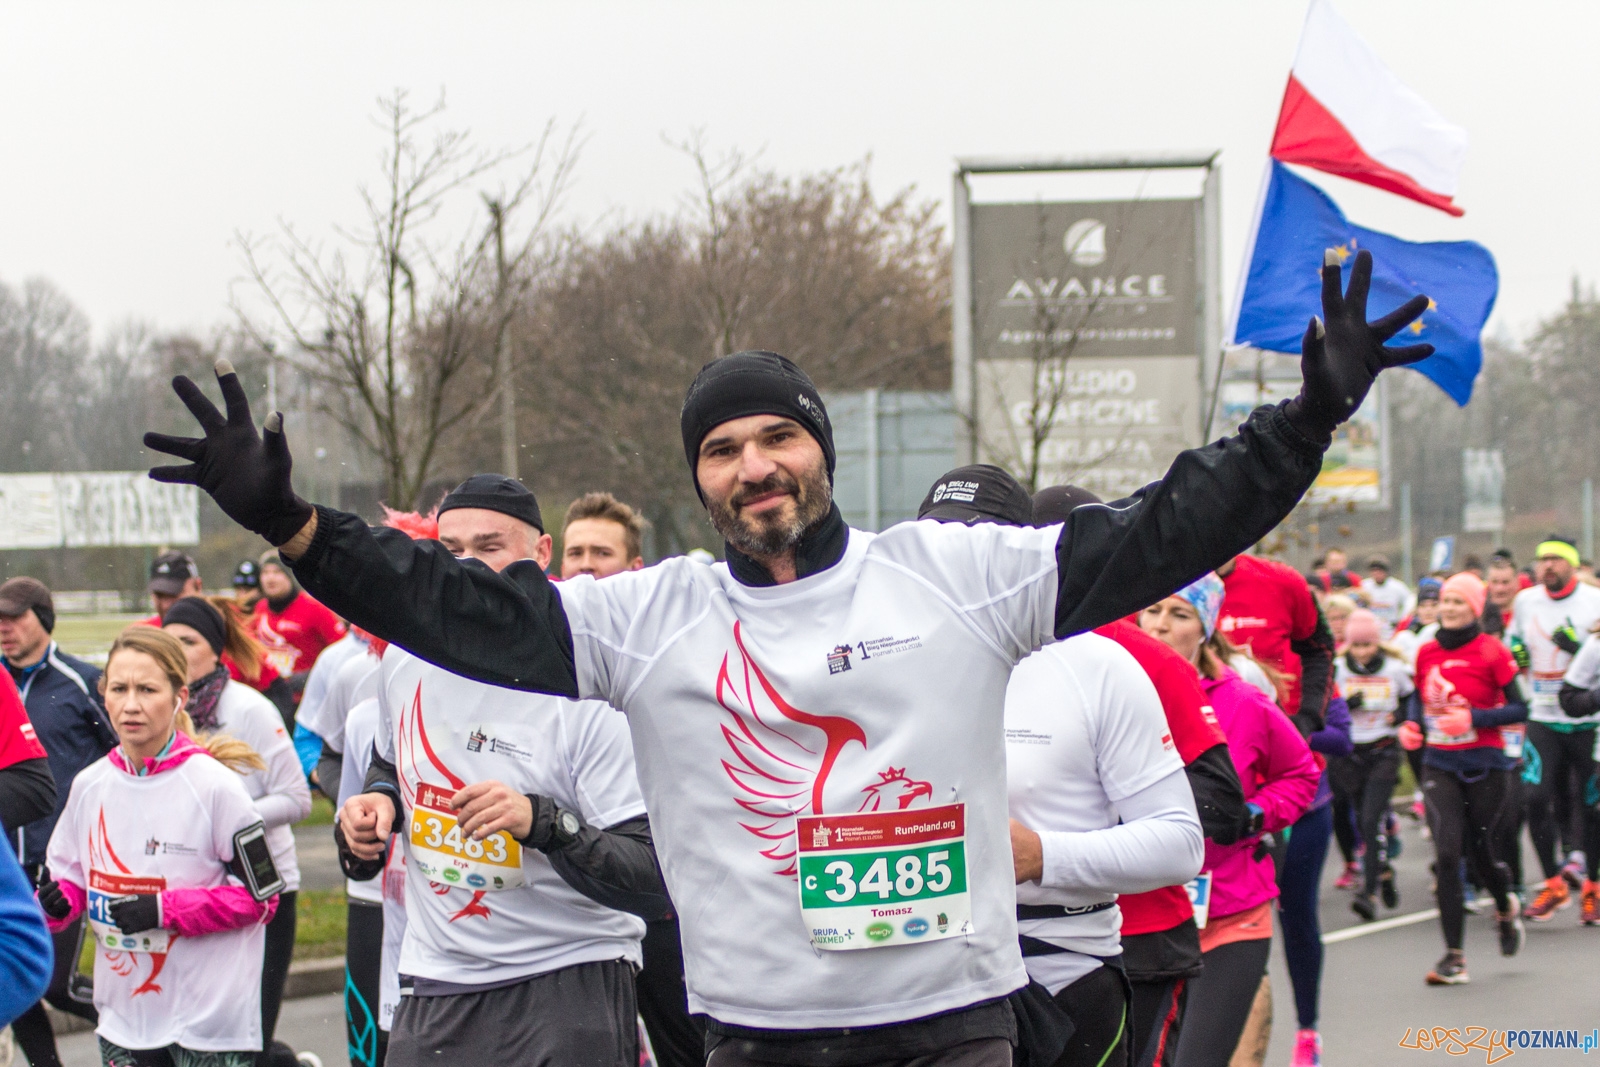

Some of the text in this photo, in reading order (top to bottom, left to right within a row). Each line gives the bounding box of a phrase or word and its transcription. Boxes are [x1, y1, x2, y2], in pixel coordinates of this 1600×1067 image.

[1006, 274, 1166, 299] AVANCE
[857, 641, 871, 661] 1
[835, 827, 844, 842] 1
[895, 820, 956, 835] RunPoland.org
[453, 859, 470, 869] Eryk
[805, 850, 952, 903] C 3485
[871, 907, 913, 917] Tomasz
[812, 928, 839, 936] GRUPA
